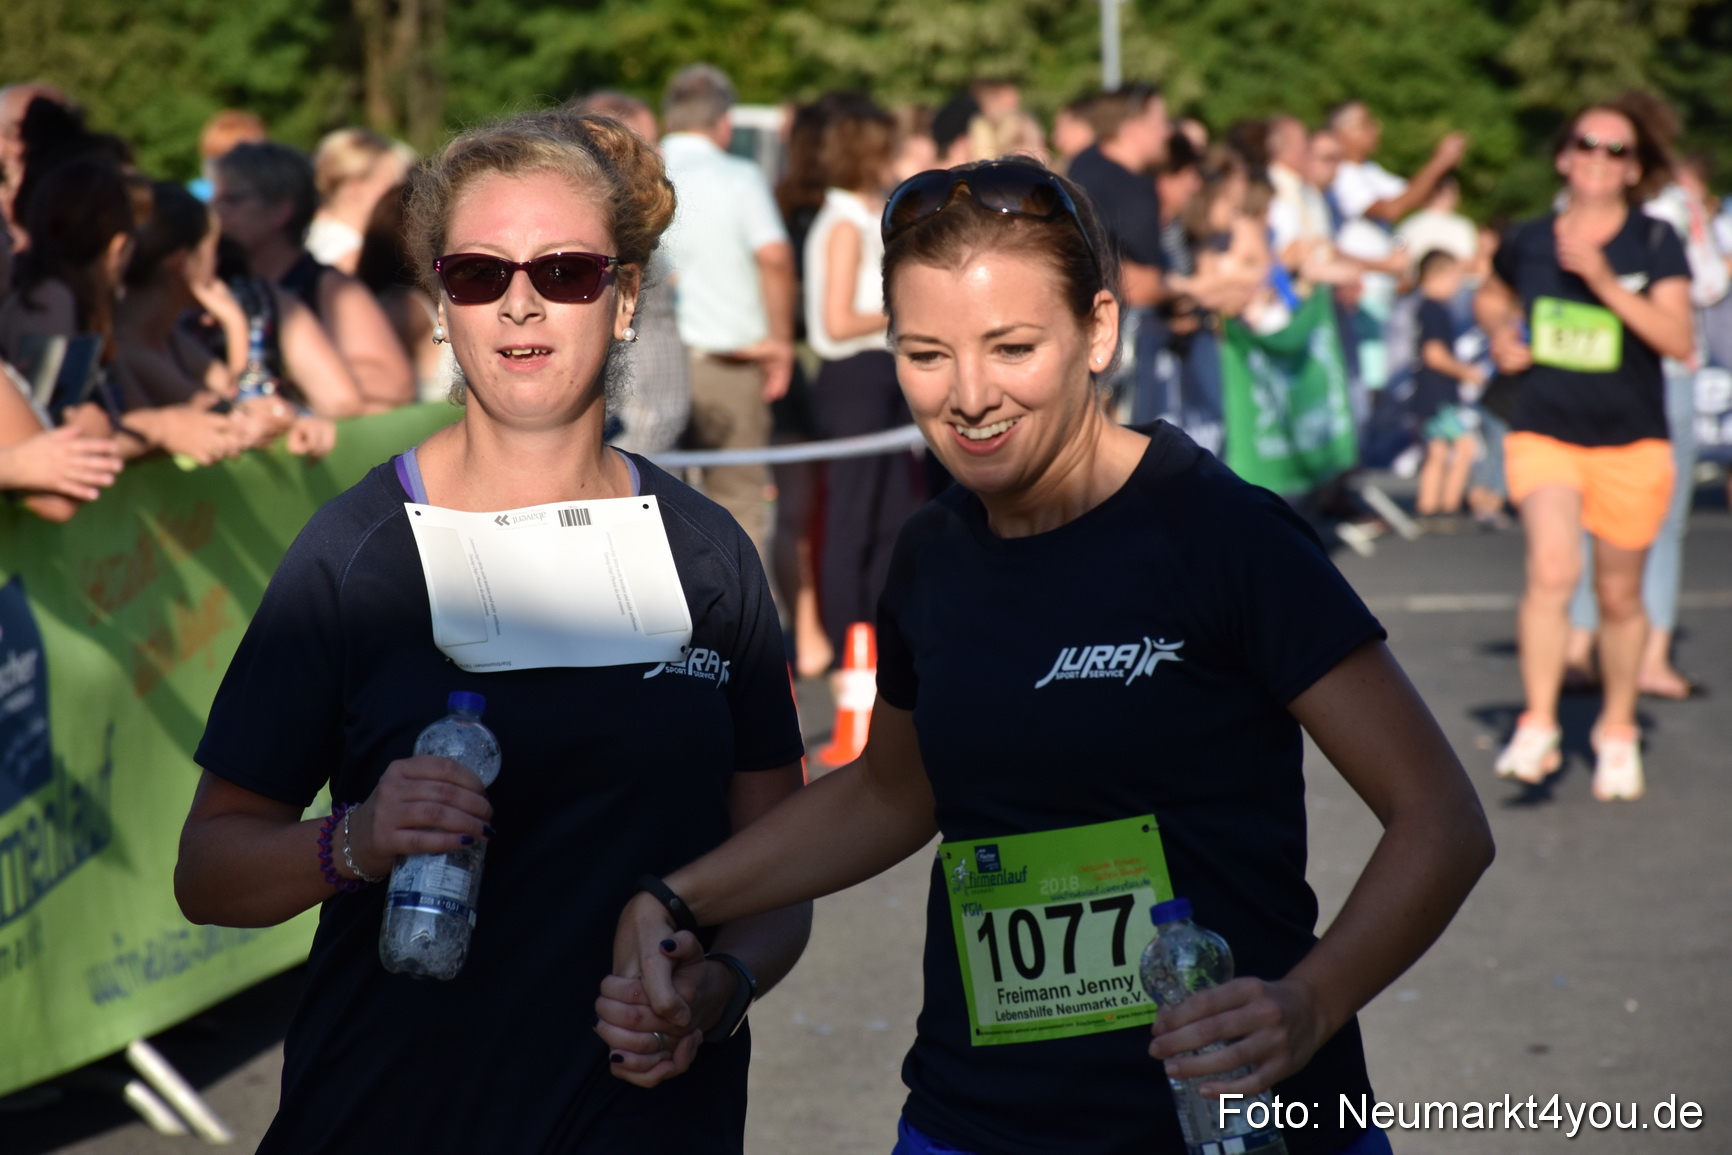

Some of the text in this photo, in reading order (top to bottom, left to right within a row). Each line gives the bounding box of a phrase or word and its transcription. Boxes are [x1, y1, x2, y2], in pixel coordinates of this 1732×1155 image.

[512, 510, 547, 524] abavent
[643, 648, 720, 680] JRA
[665, 666, 716, 681] SPORT SERVICE
[1034, 644, 1141, 689] JURA
[1055, 669, 1124, 680] SPORT SERVICE
[968, 866, 1028, 888] firmenlauf
[1040, 876, 1080, 895] 2018
[977, 894, 1136, 983] 1077
[997, 975, 1135, 1005] Freimann Jenny
[995, 991, 1147, 1022] Lebenshilfe Neumarkt e.V.
